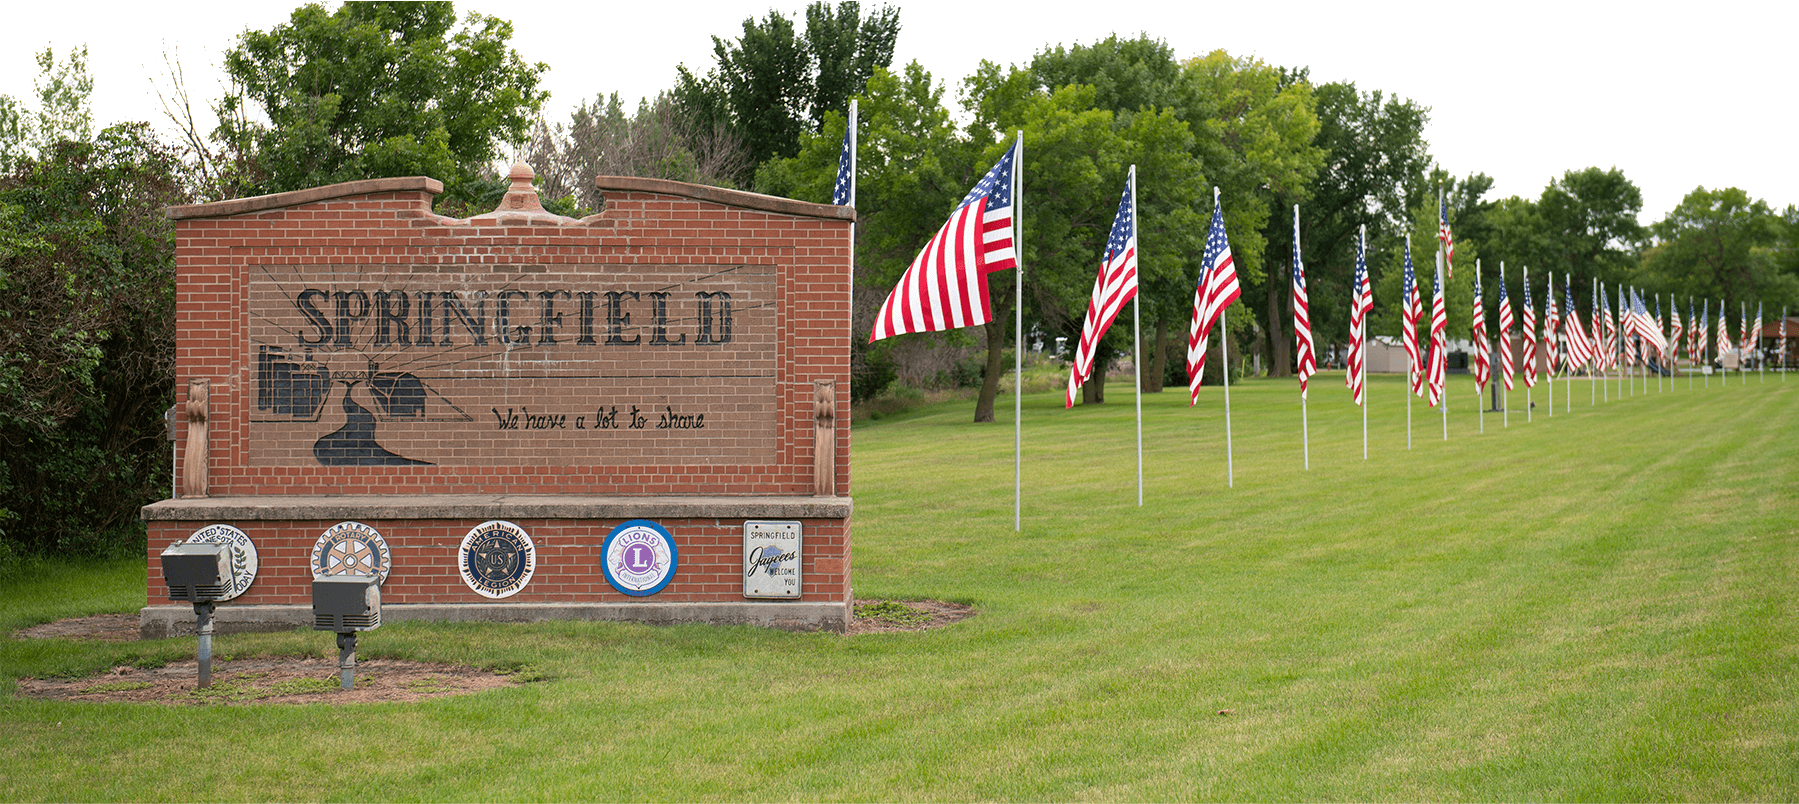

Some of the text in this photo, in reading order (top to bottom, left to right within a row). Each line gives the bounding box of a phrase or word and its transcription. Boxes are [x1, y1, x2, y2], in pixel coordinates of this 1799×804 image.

[297, 288, 732, 347] SPRINGFIELD
[492, 405, 705, 430] We have a lot to share
[192, 527, 248, 547] NITED STATES
[334, 531, 367, 541] ROTARY
[471, 530, 524, 552] AMERICAN
[622, 532, 657, 545] LIONS
[750, 531, 796, 540] SPRINGFIELD
[490, 554, 504, 565] US
[632, 547, 648, 567] L
[747, 545, 797, 578] Jaycees
[769, 567, 796, 576] WELCOME
[236, 570, 254, 592] ODAY
[478, 576, 516, 588] LEGION
[784, 578, 796, 586] YOU
